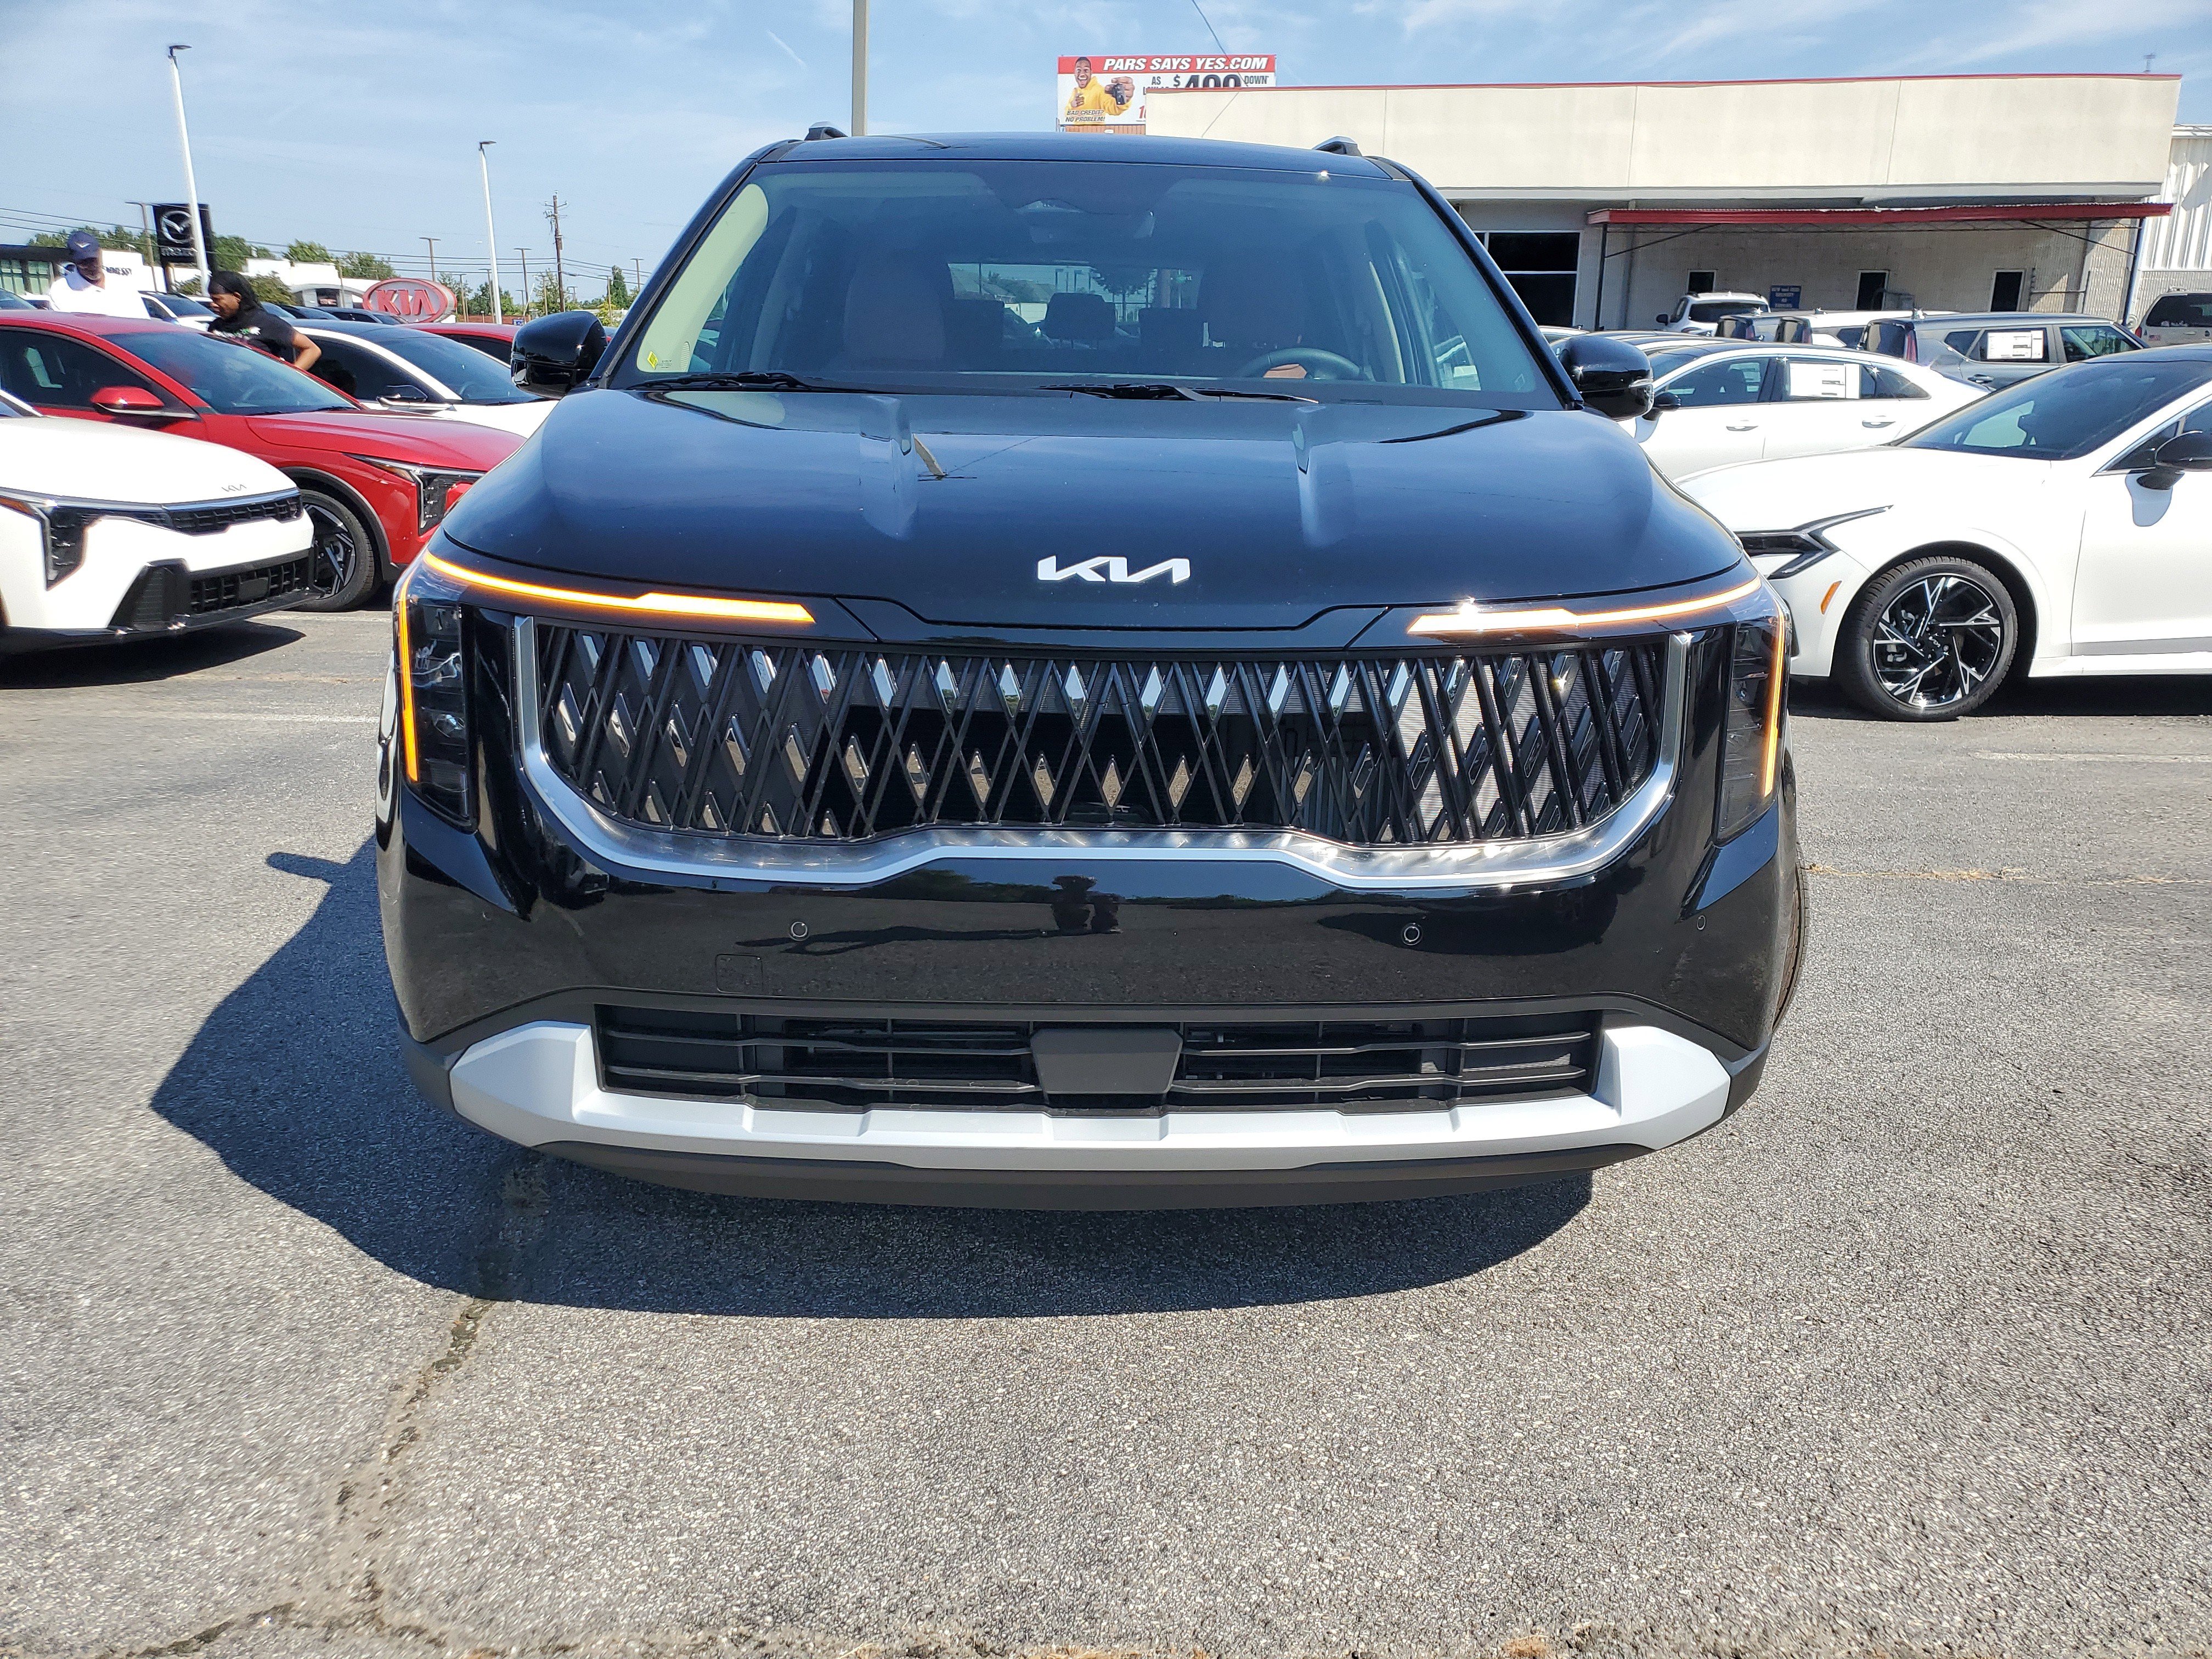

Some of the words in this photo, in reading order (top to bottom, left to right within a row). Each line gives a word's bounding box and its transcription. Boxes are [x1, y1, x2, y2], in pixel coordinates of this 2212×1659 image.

[1103, 58, 1147, 71] PARS
[1149, 57, 1192, 71] SAYS
[1195, 57, 1268, 71] YES.COM
[1152, 76, 1161, 85] AS
[375, 289, 437, 315] KIA
[1038, 555, 1190, 584] KIA
